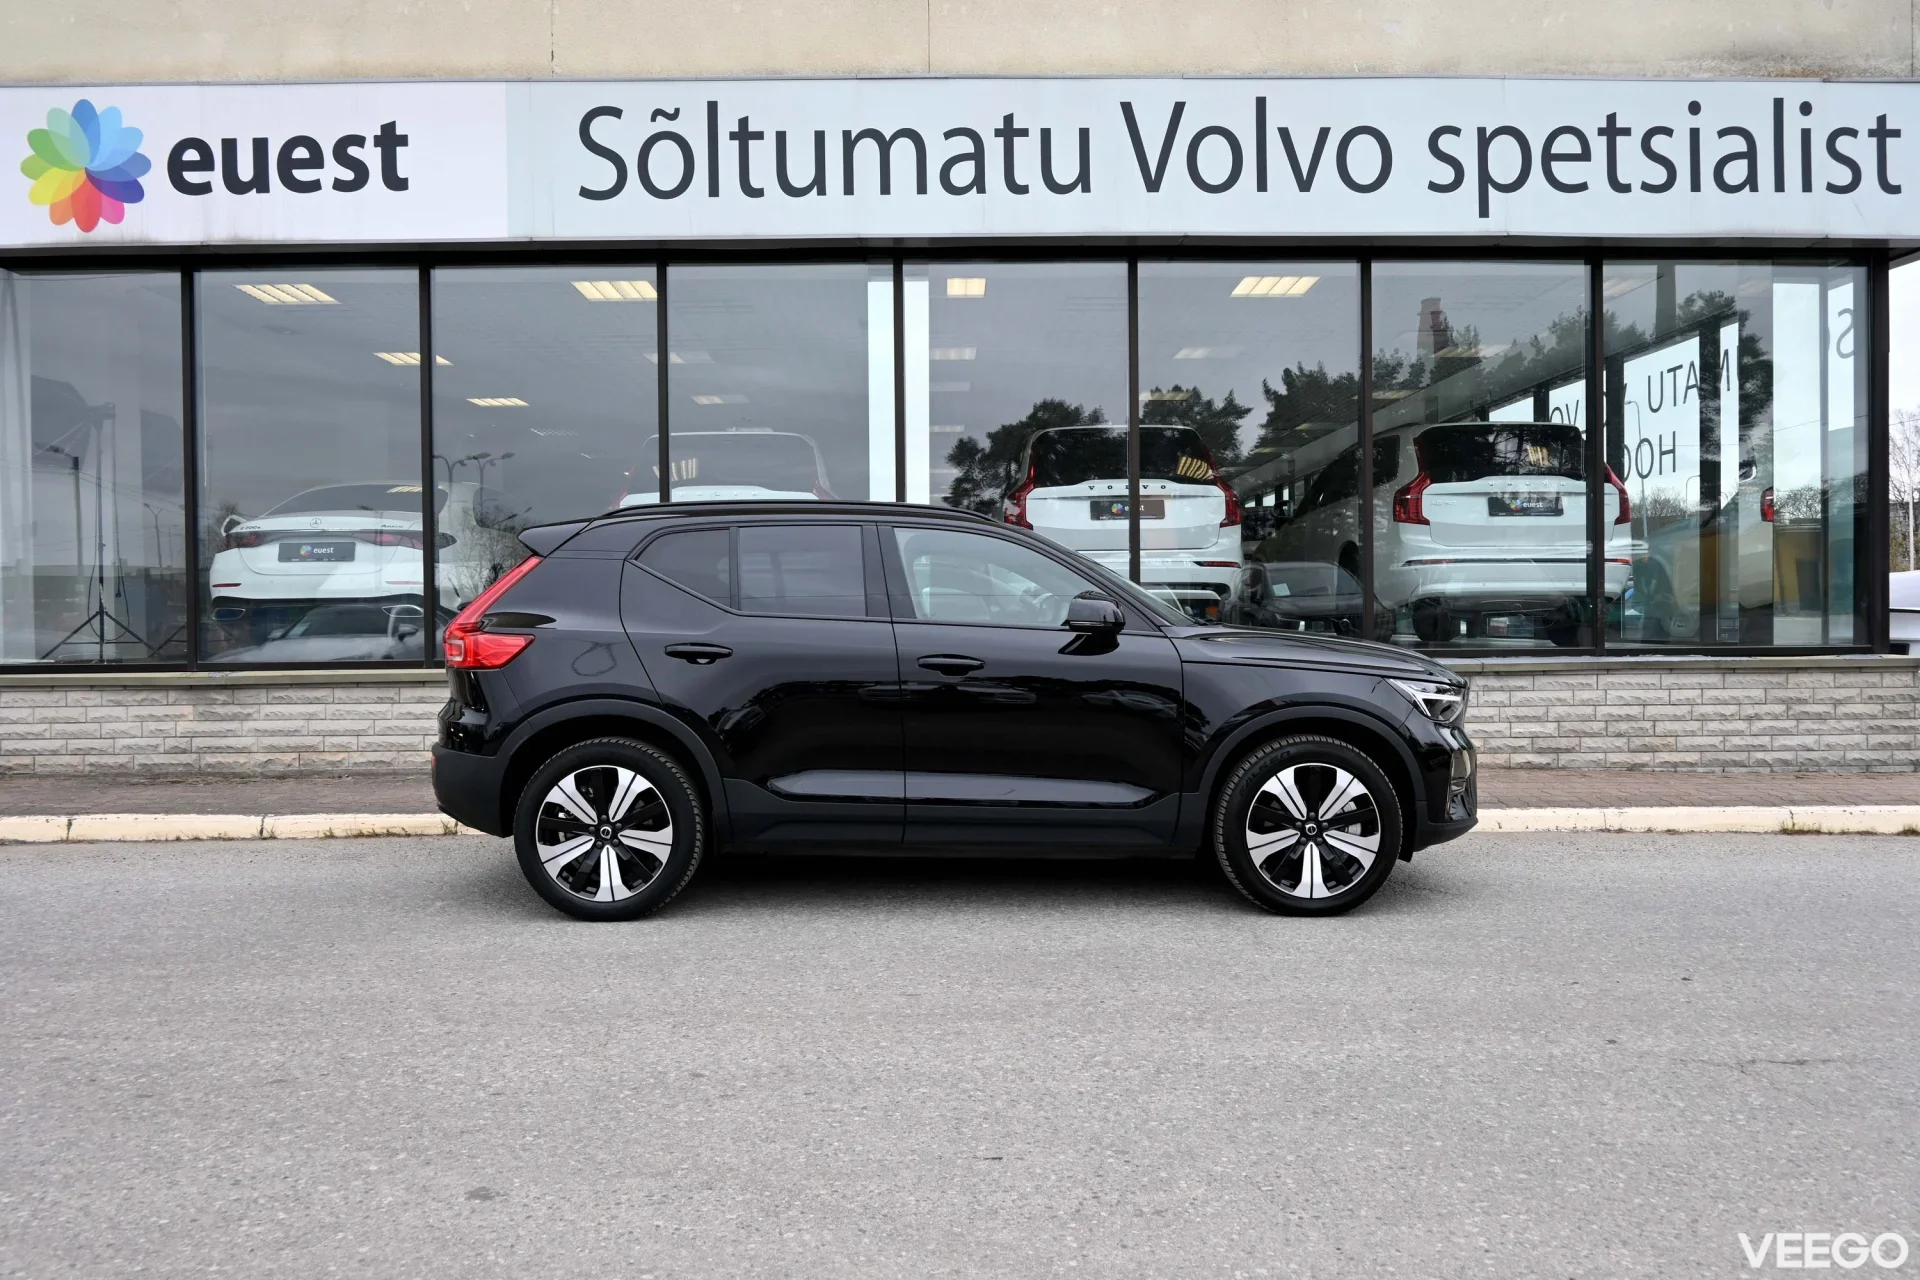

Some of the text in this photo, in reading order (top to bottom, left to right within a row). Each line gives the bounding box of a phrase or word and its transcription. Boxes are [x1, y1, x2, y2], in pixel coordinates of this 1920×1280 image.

[166, 120, 409, 196] euest
[578, 96, 1902, 219] Sõltumatu Volvo spetsialist
